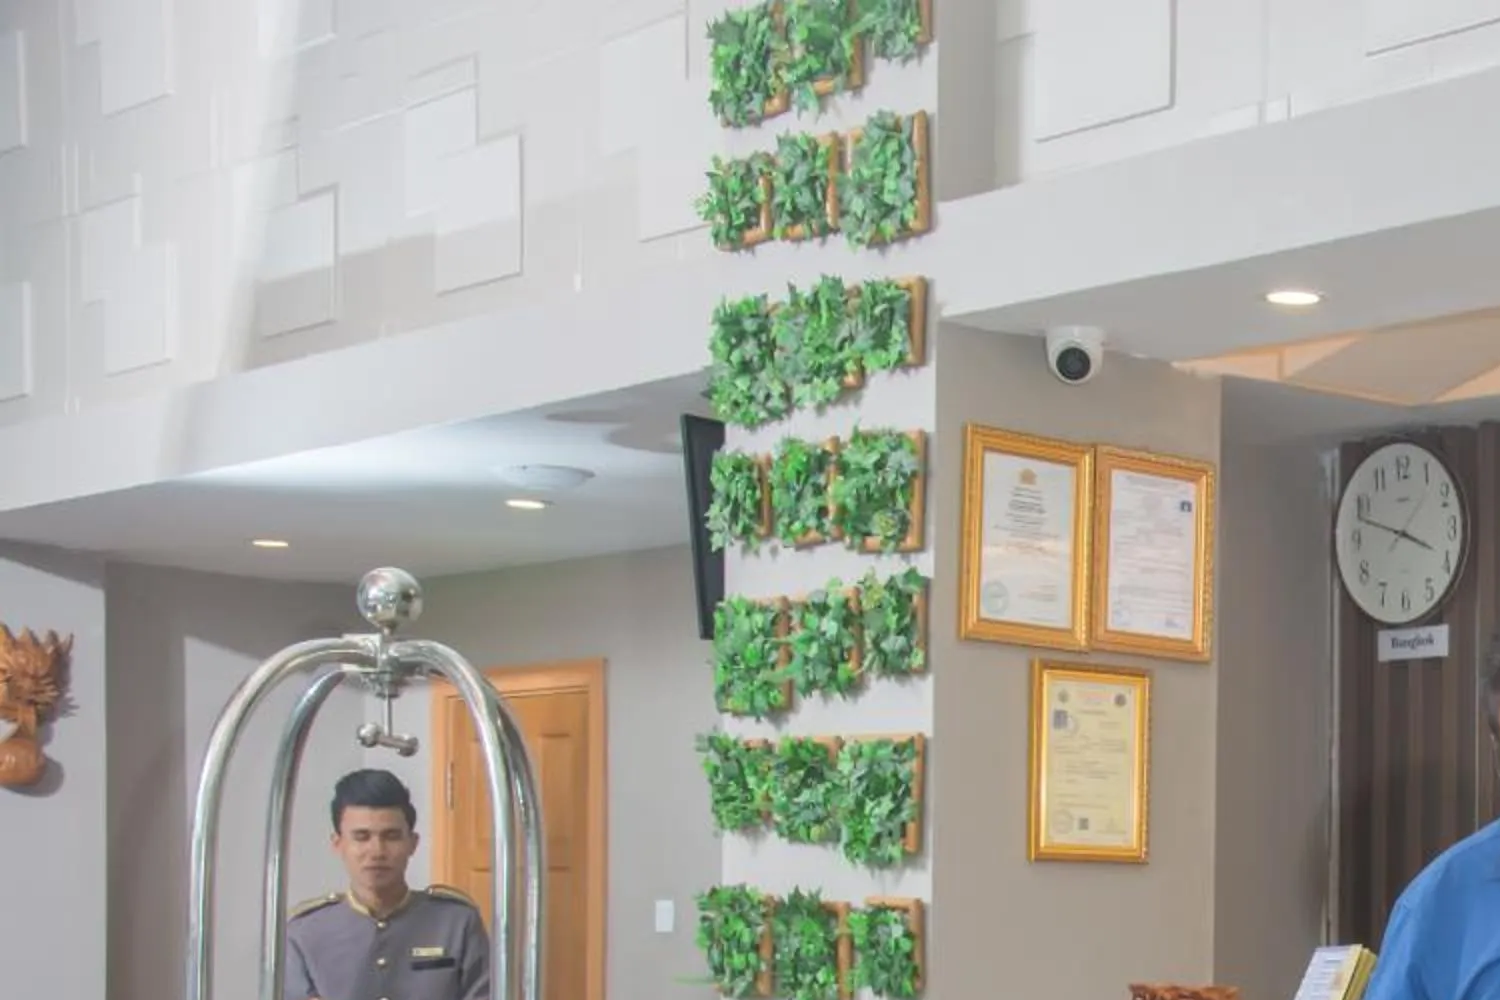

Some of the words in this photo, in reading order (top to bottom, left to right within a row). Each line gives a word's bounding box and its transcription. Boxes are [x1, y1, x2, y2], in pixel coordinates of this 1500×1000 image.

[1374, 465, 1386, 492] 11
[1395, 455, 1411, 482] 12
[1356, 494, 1371, 520] 10
[1440, 482, 1450, 508] 2
[1352, 529, 1362, 551] 9
[1449, 515, 1457, 541] 3
[1359, 560, 1370, 585] 8
[1443, 550, 1450, 574] 4
[1378, 582, 1388, 608] 7
[1401, 589, 1411, 612] 6
[1425, 577, 1435, 602] 5
[1390, 632, 1435, 651] Bangkok
